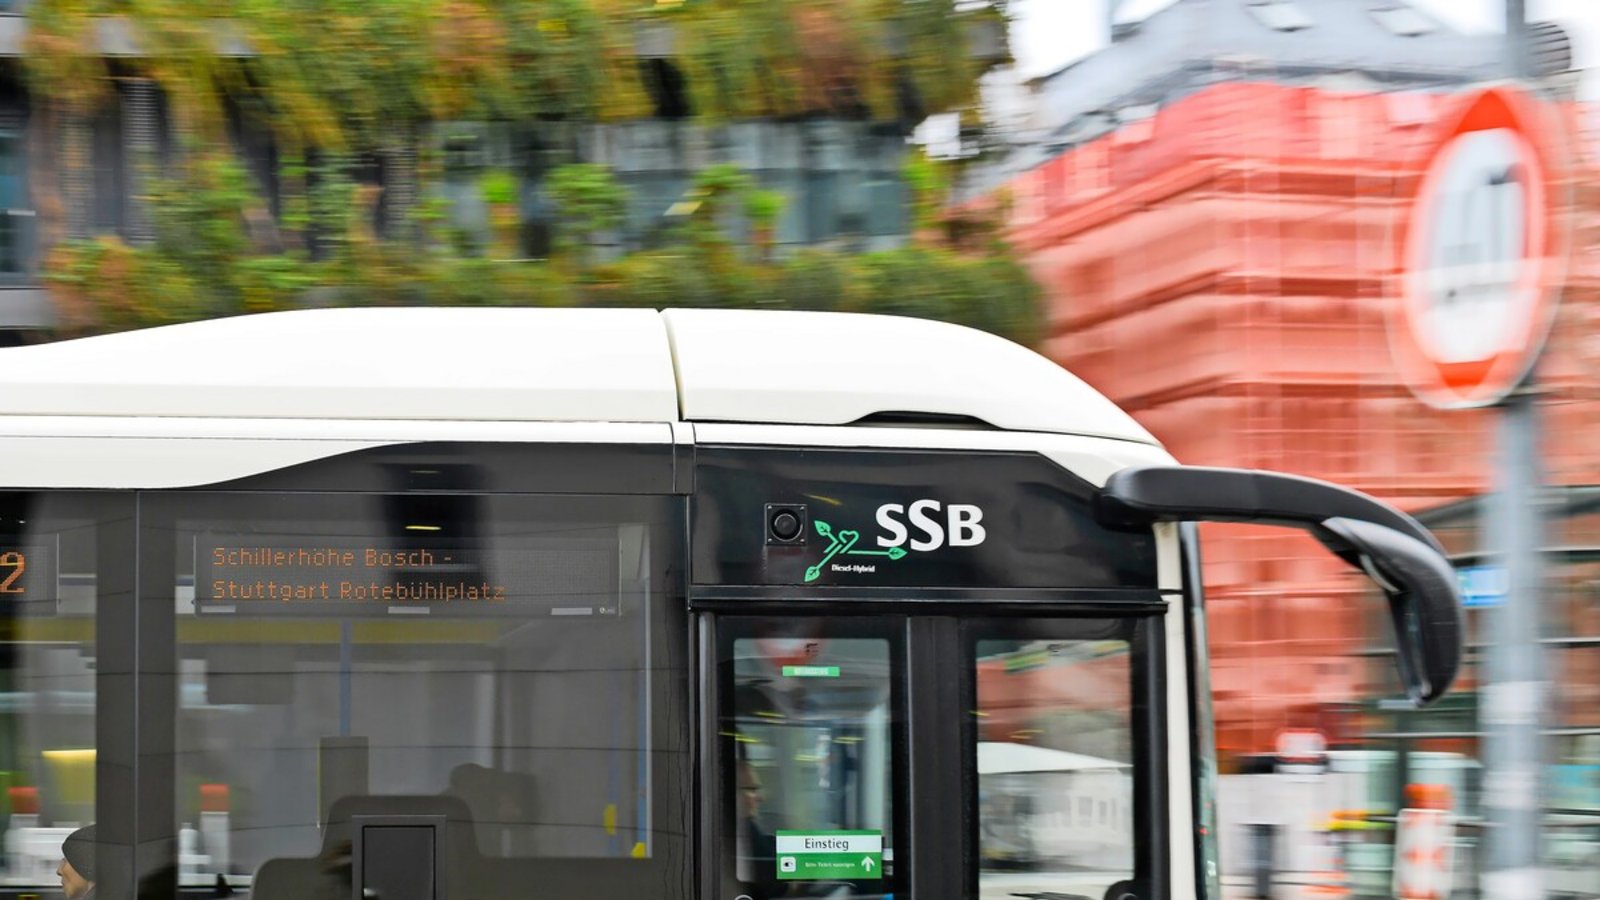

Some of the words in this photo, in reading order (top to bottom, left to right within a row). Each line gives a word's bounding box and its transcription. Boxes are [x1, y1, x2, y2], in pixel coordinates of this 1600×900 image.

[875, 499, 987, 552] SSB
[212, 547, 355, 567] Schillerhöhe
[364, 548, 434, 567] Bosch
[831, 563, 876, 574] Diesel-Hybrid
[212, 580, 330, 601] Stuttgart
[339, 580, 506, 602] Rotebühlplatz
[804, 837, 849, 852] Einstieg
